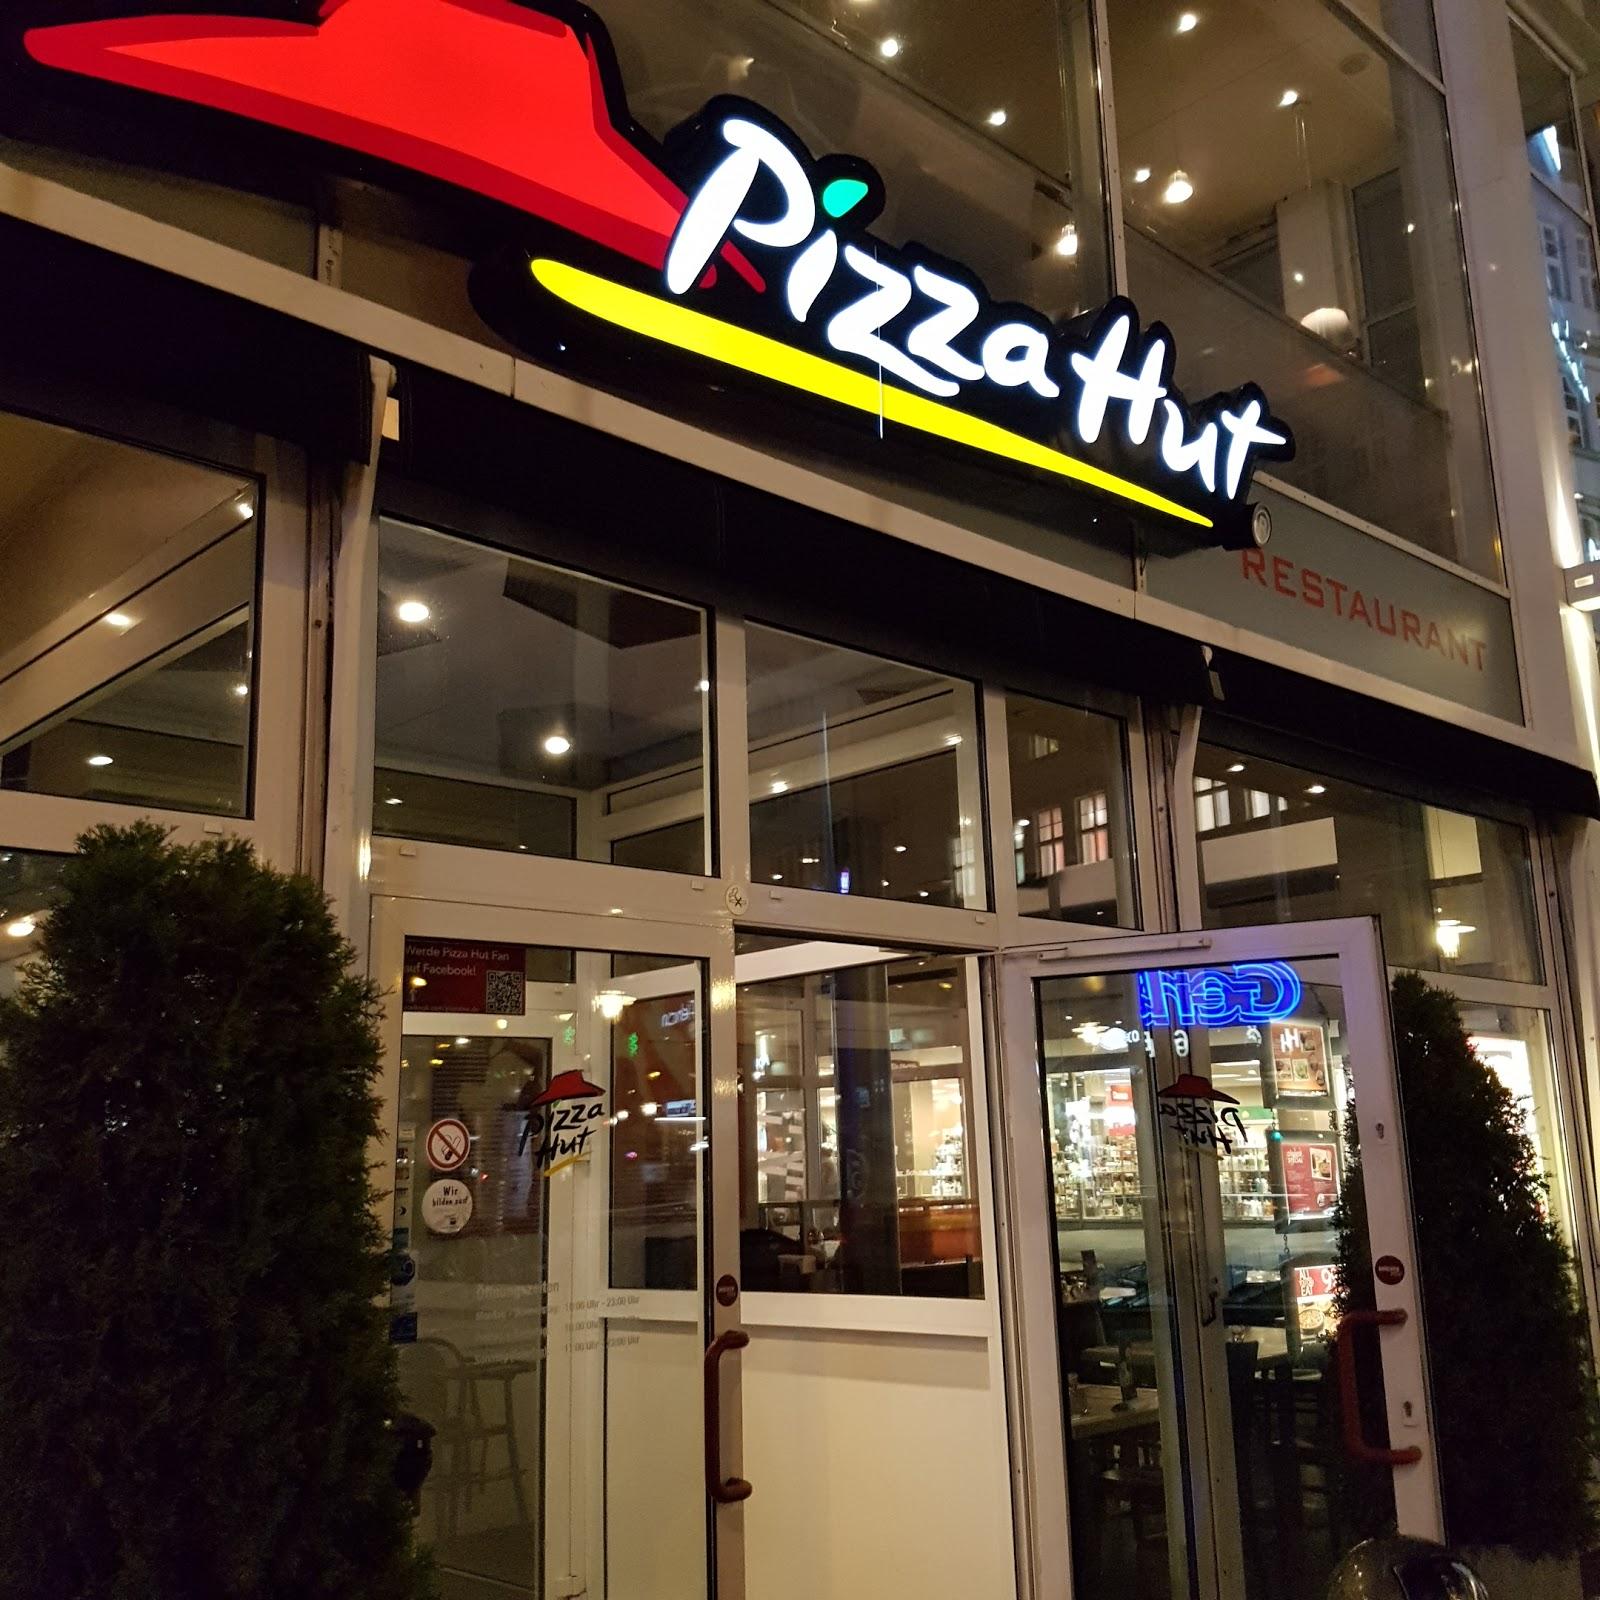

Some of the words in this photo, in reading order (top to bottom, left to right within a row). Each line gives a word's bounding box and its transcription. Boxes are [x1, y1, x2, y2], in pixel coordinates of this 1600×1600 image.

[666, 117, 1060, 397] Pizza
[1072, 315, 1287, 500] Hut
[1241, 548, 1487, 671] RESTAURANT
[423, 963, 477, 976] Facebook!
[443, 946, 469, 959] Pizza
[471, 949, 489, 961] Hut
[492, 950, 510, 961] Fan
[518, 1102, 606, 1157] Pizza
[535, 1126, 598, 1168] Hut
[443, 1186, 458, 1196] Wir
